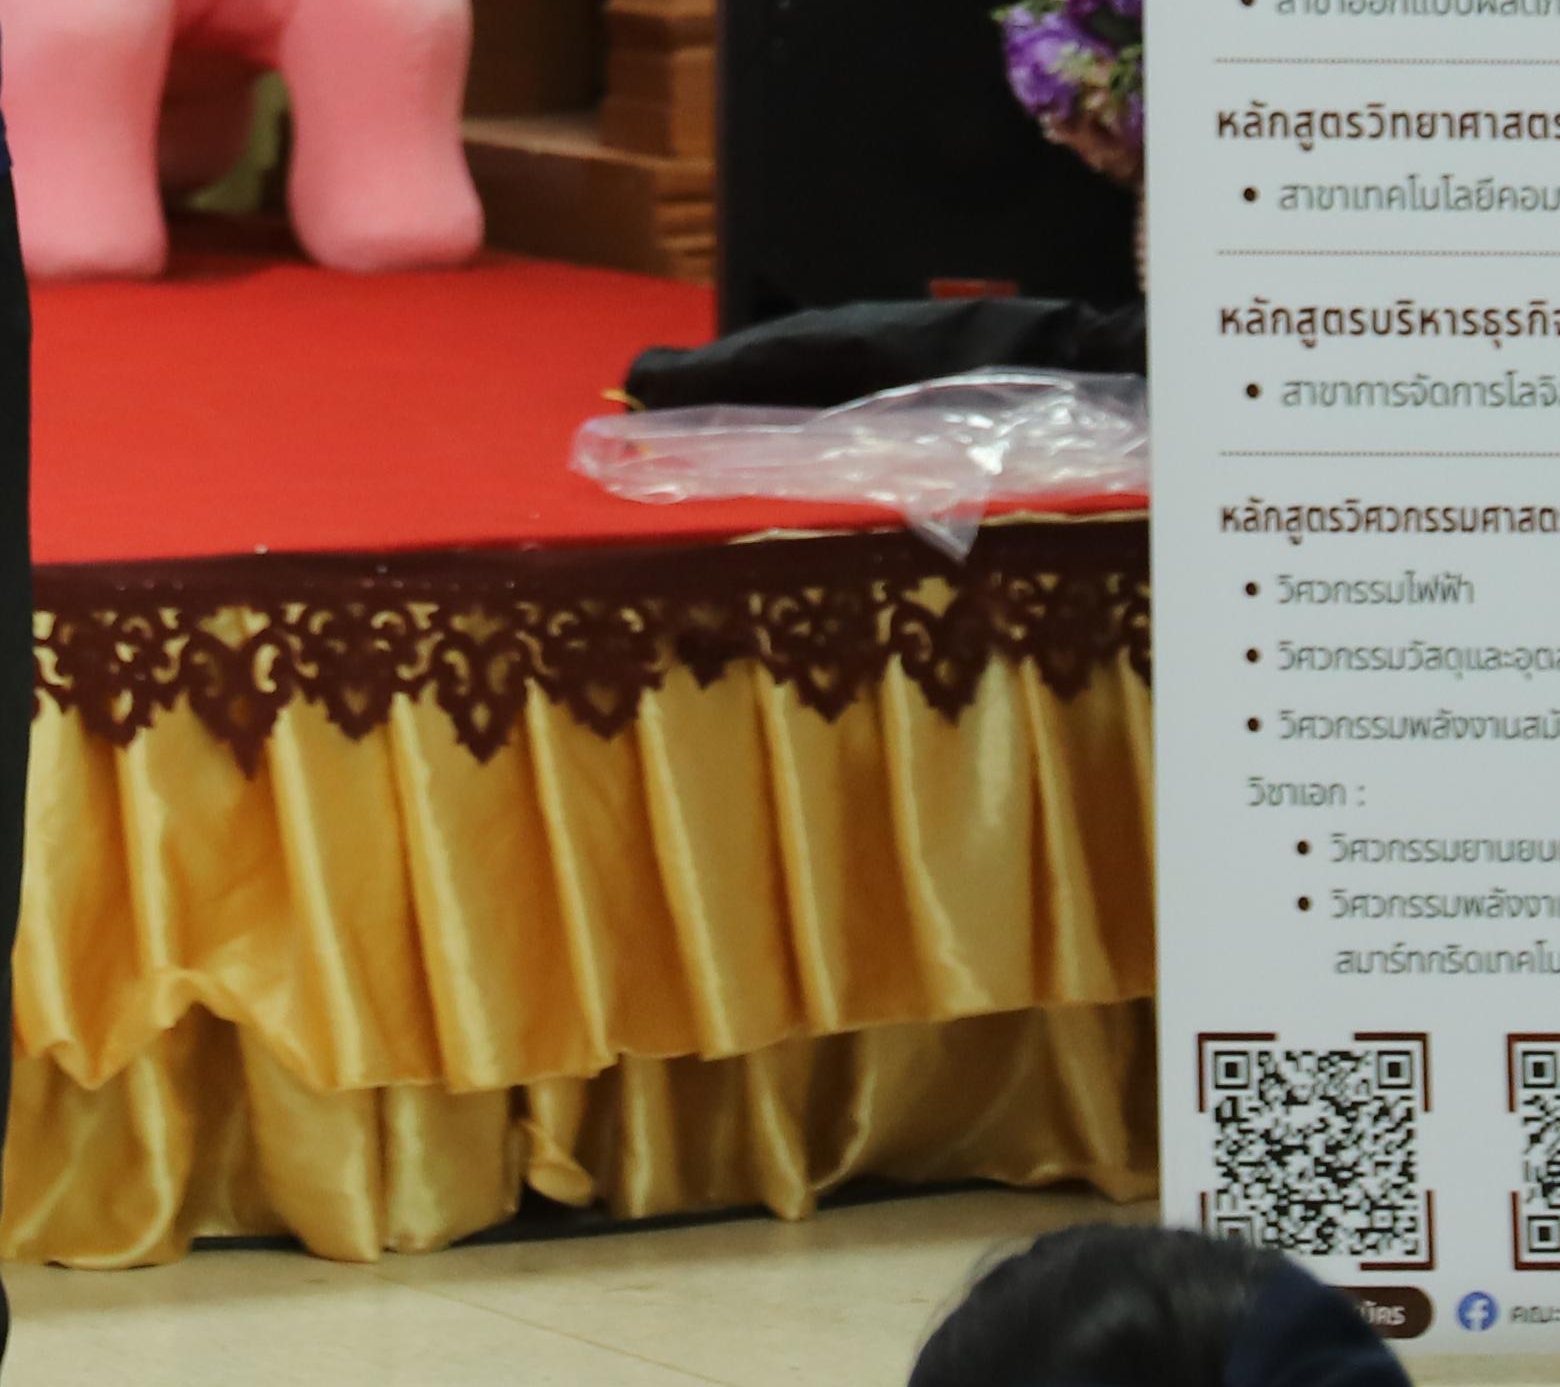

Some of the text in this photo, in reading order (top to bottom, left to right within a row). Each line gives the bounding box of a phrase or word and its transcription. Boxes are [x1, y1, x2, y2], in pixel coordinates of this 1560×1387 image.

[1277, 568, 1475, 605] วิศวกรรมไฟฟ้า
[1247, 775, 1347, 808] วิชาเอก
